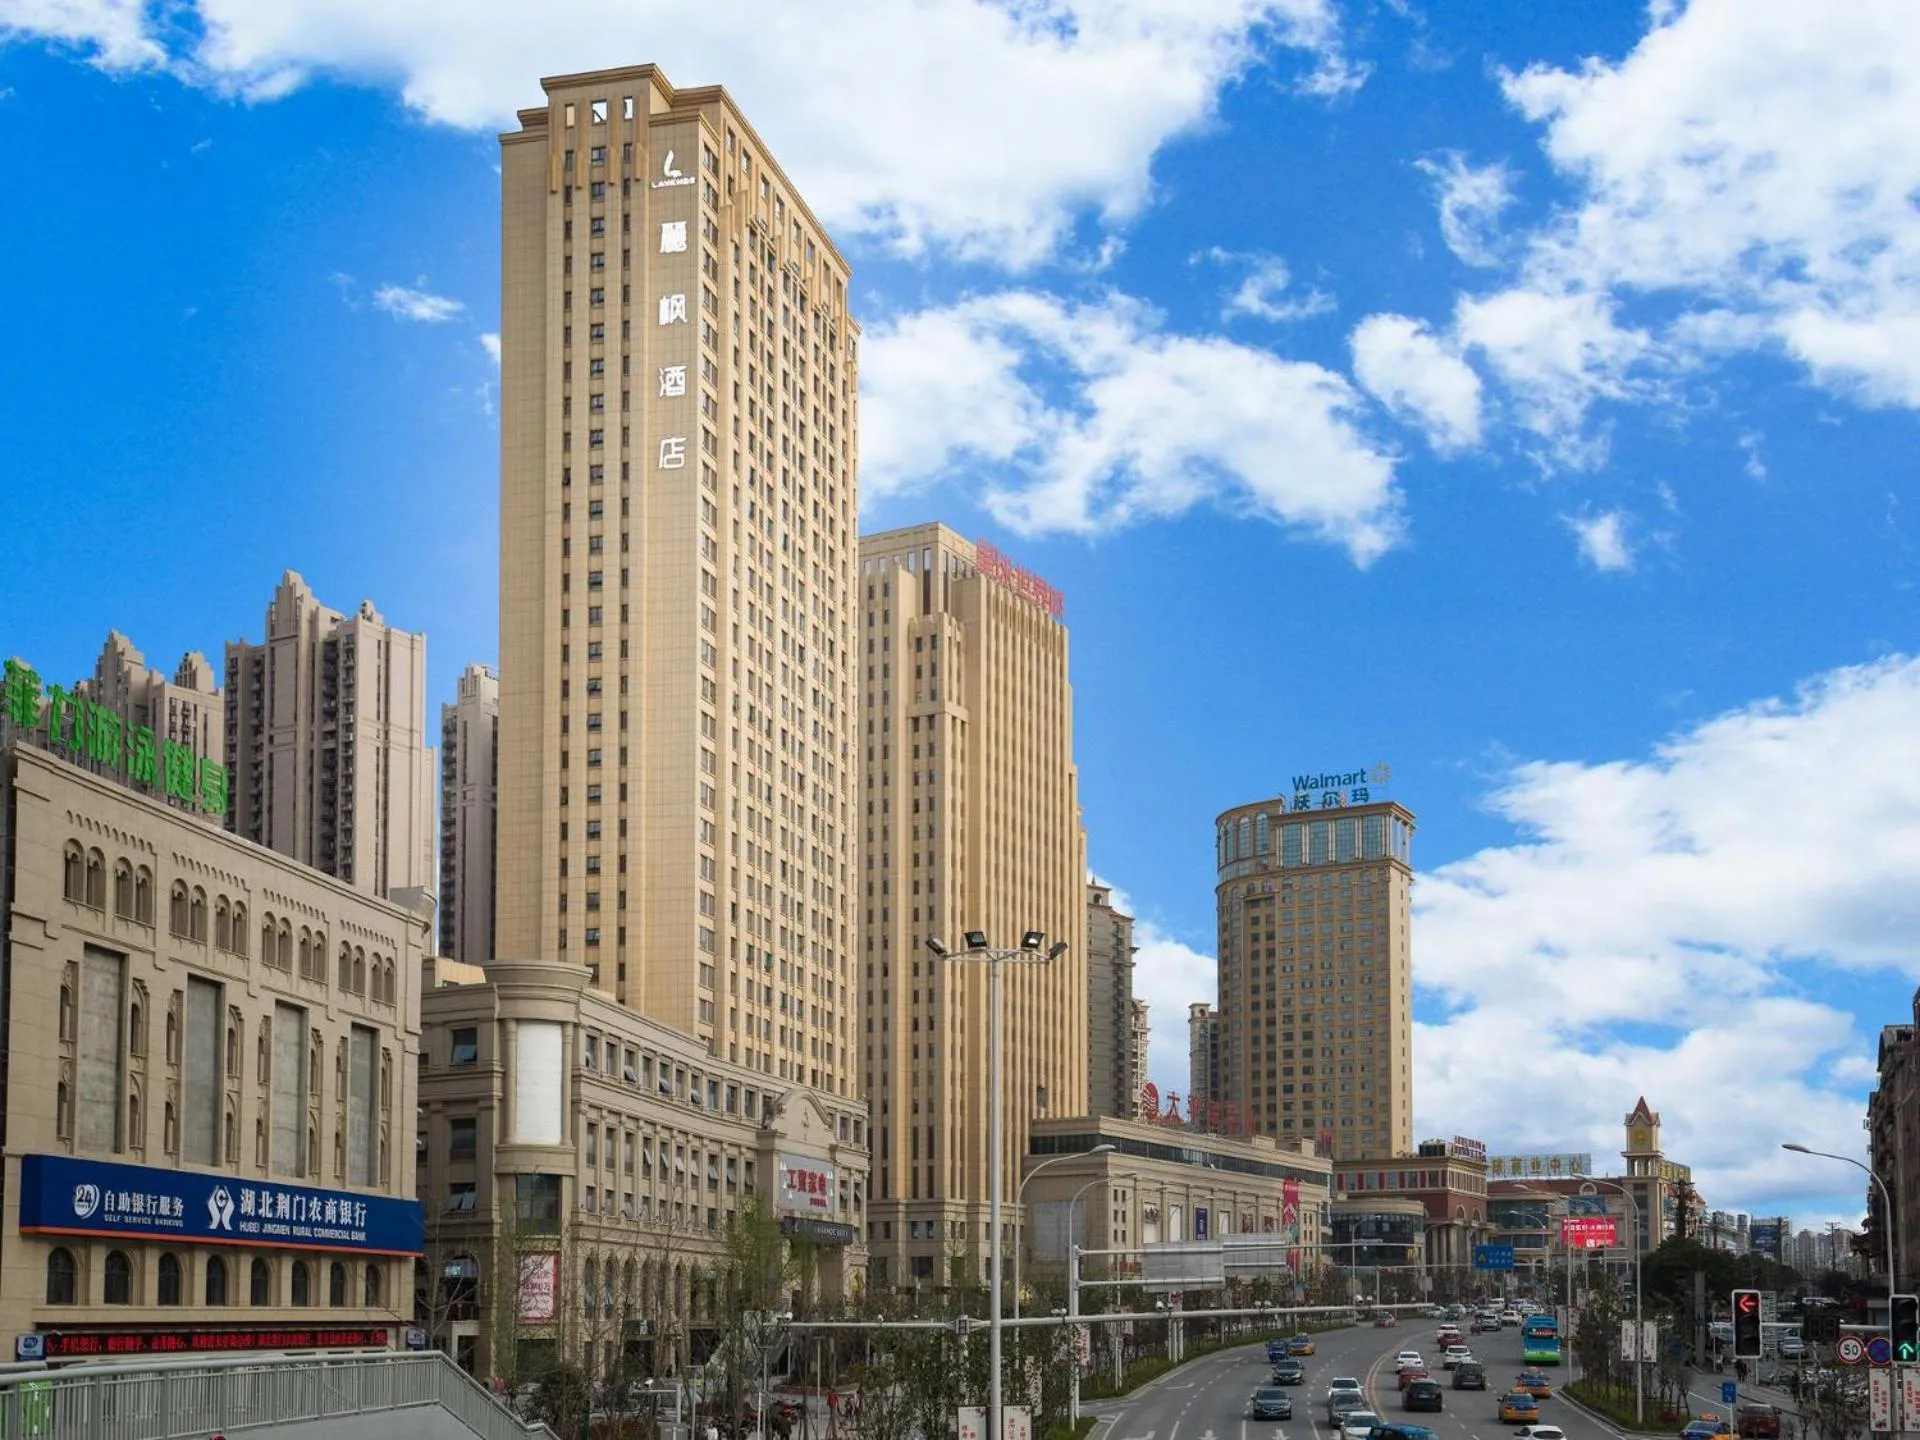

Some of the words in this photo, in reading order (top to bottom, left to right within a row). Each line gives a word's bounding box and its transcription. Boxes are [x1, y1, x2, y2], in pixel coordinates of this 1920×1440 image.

[1292, 768, 1368, 791] Walmart
[1293, 787, 1370, 810] 沃尔玛
[104, 1190, 184, 1217] 自助银行服务
[240, 1187, 367, 1228] 湖北荆门农商银行
[104, 1214, 121, 1222] SELF
[124, 1216, 152, 1226] SERVICE
[155, 1218, 184, 1228] BANKING
[240, 1222, 259, 1233] HUBEI
[262, 1223, 290, 1236] JINGMEN
[293, 1225, 313, 1237] RURAL
[314, 1227, 350, 1240] COMMERCIAL
[351, 1230, 367, 1242] BANK
[1843, 1344, 1859, 1355] 50
